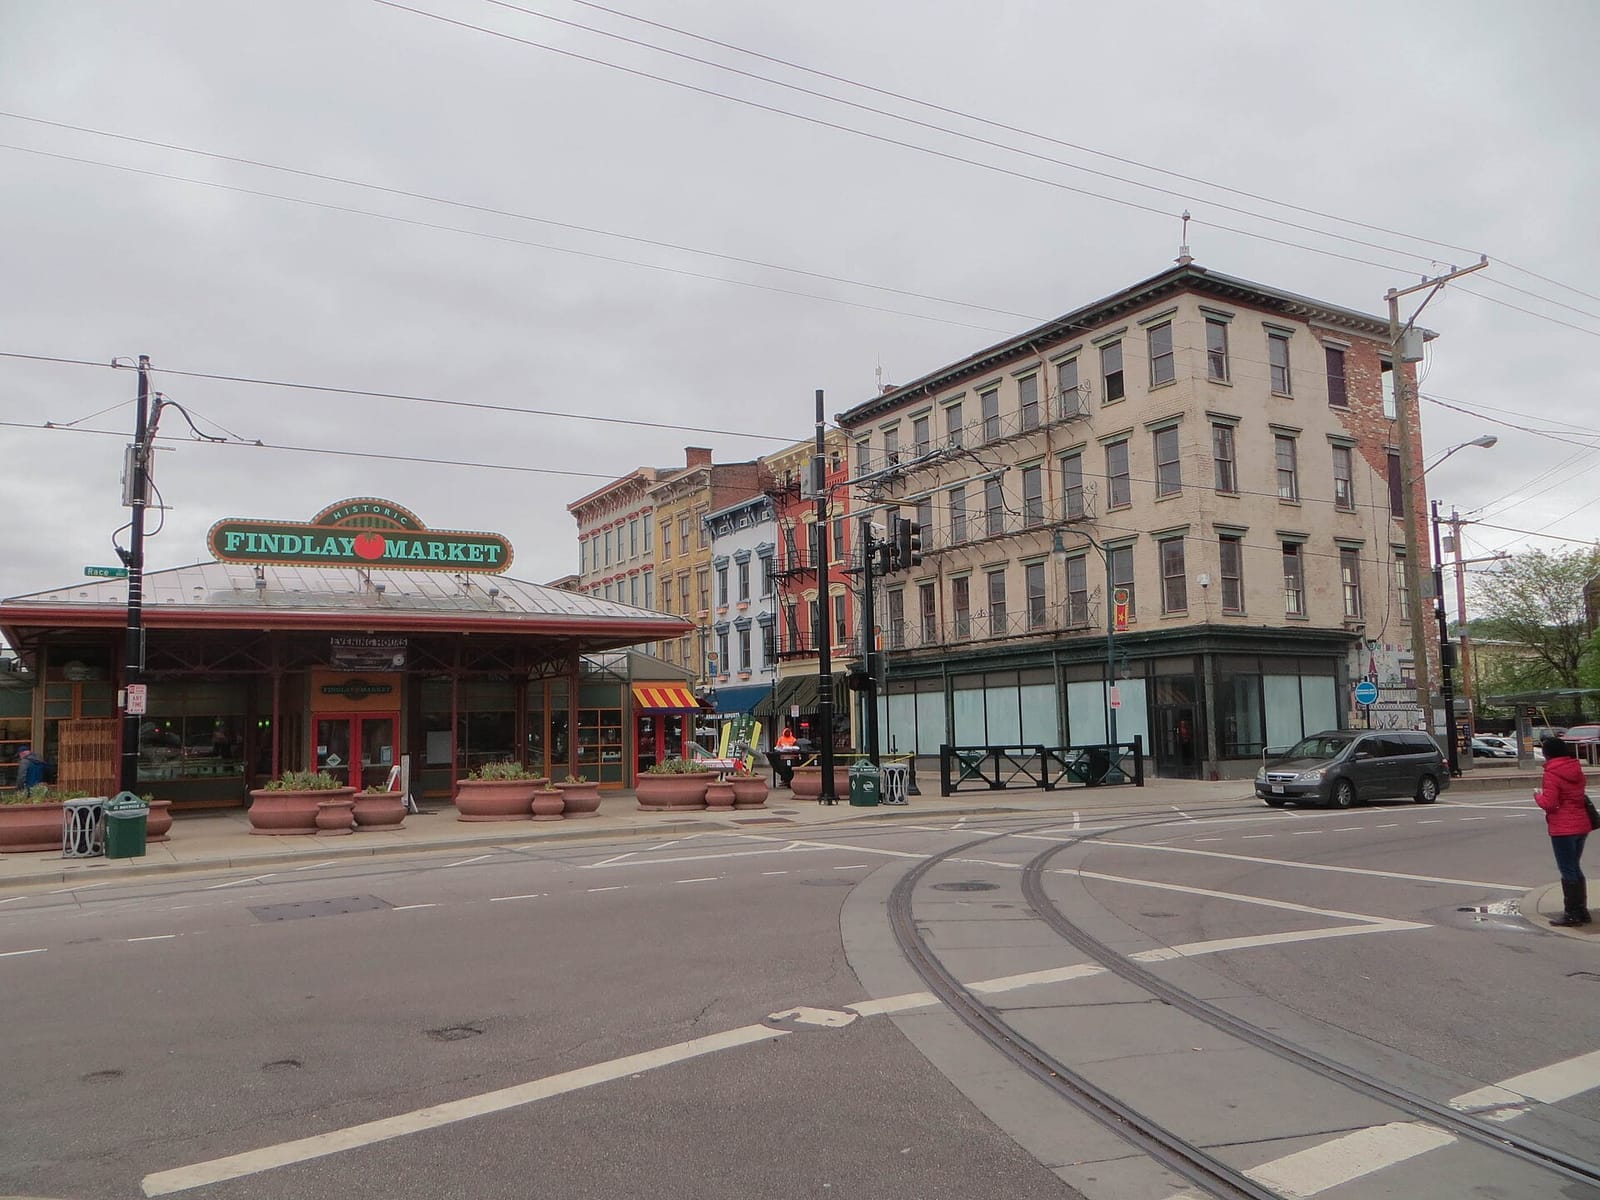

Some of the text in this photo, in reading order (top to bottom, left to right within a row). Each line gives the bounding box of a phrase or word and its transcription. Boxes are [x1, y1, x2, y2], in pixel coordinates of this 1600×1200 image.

[333, 505, 408, 524] HISTORIC
[224, 531, 500, 563] FINDLAY MARKET
[87, 567, 109, 576] Race
